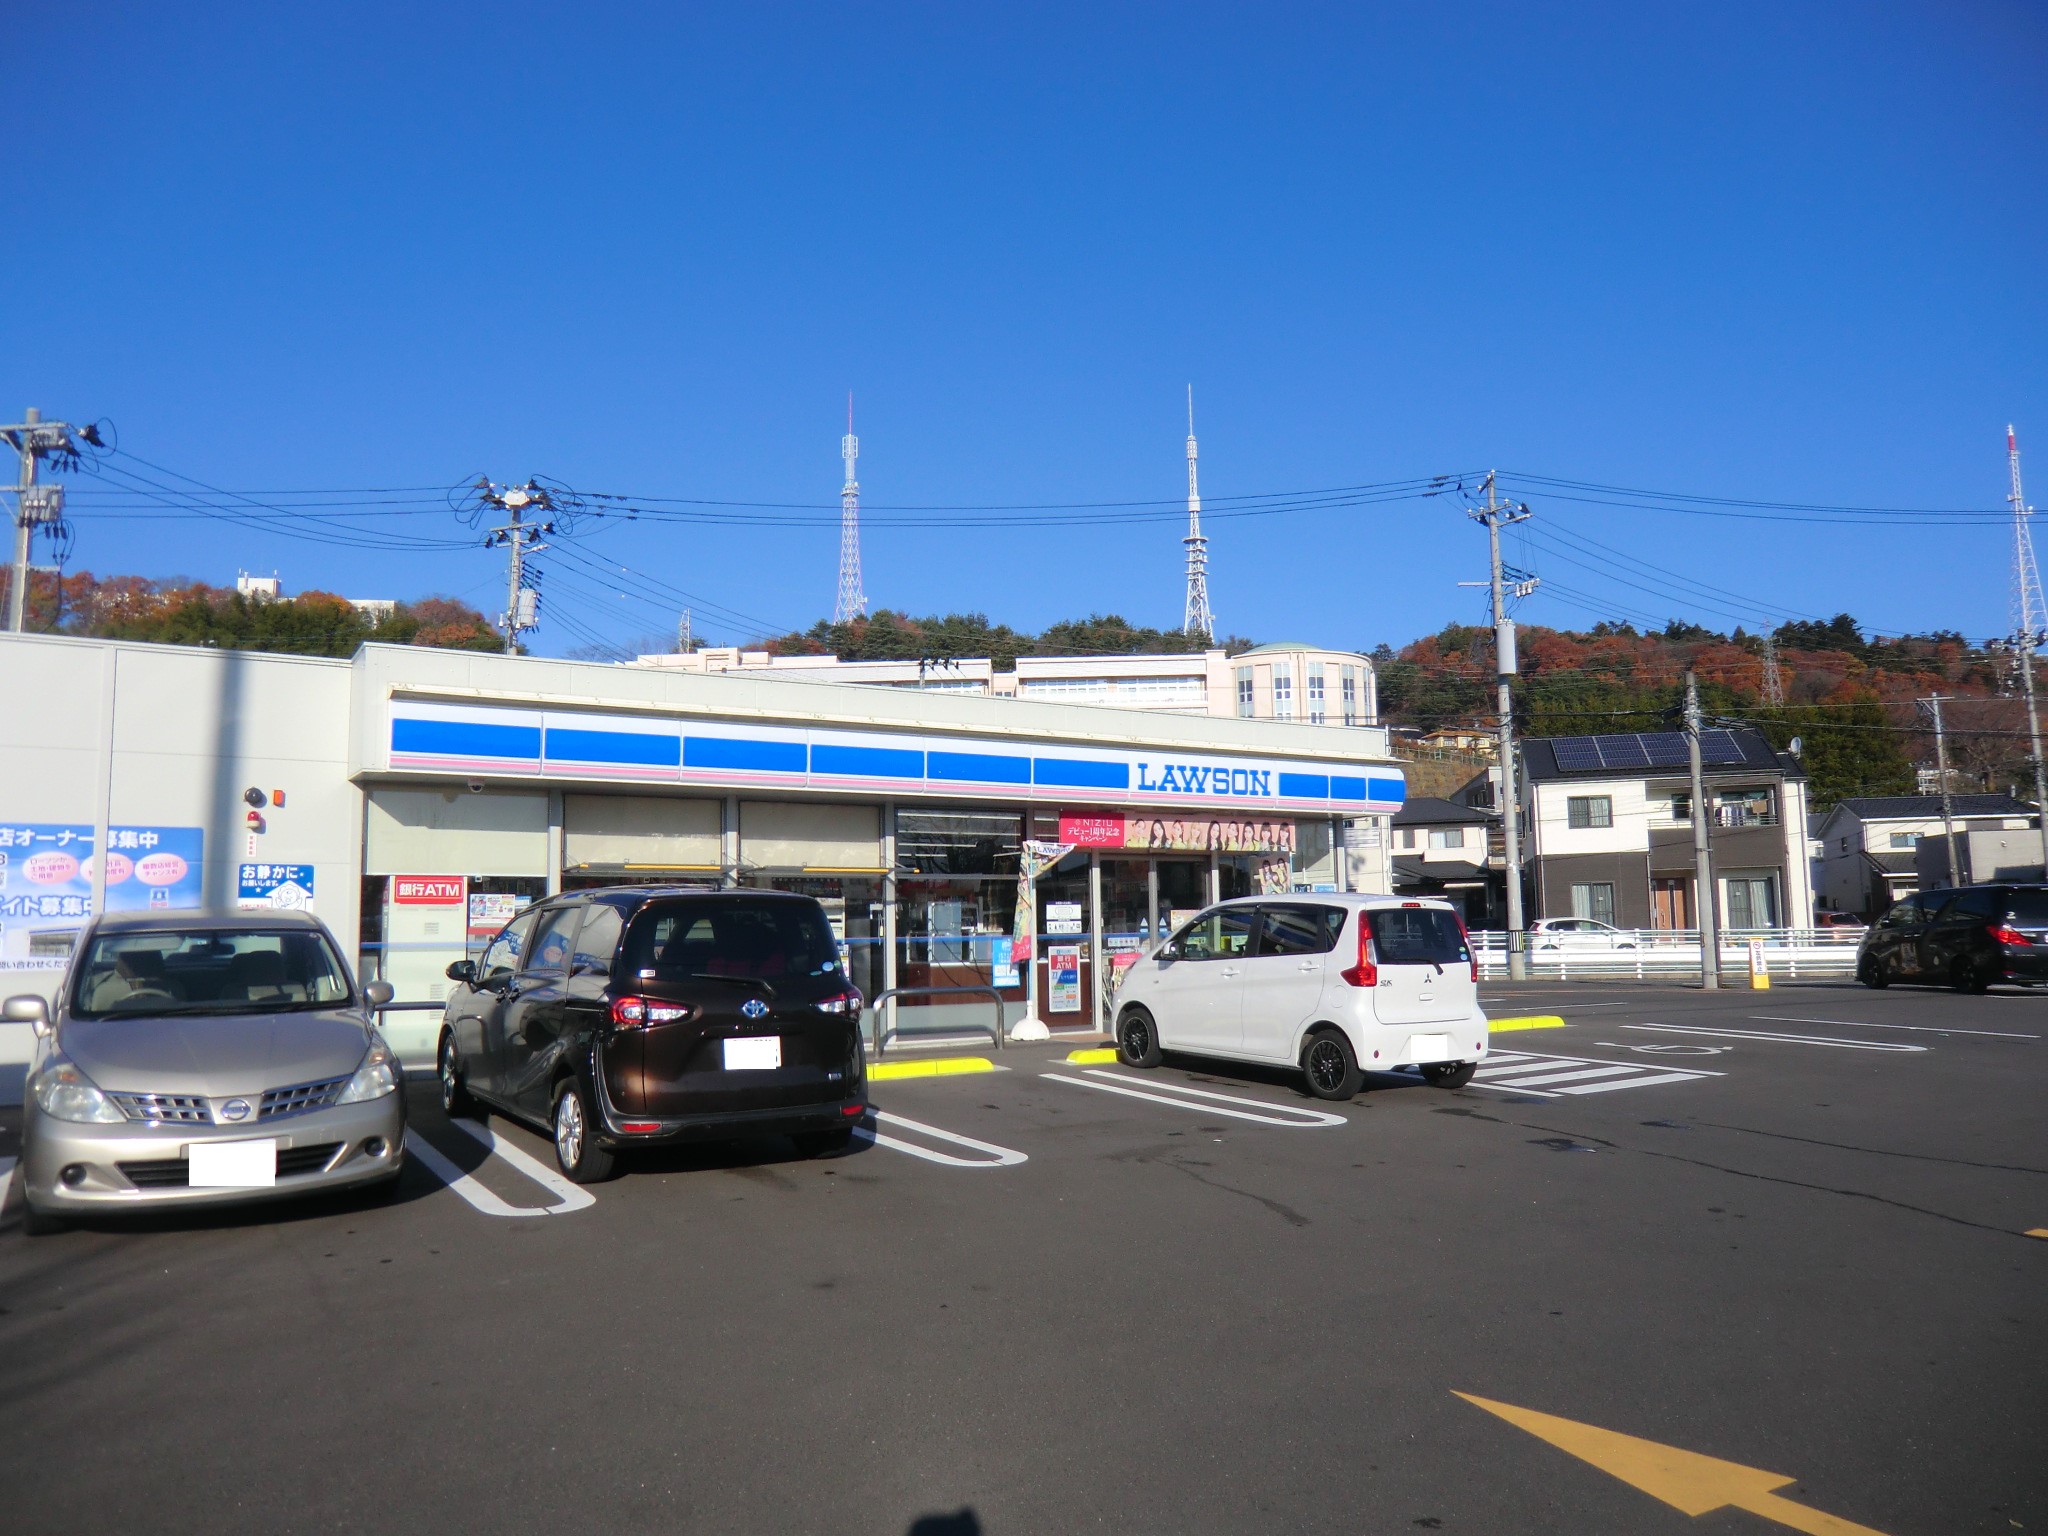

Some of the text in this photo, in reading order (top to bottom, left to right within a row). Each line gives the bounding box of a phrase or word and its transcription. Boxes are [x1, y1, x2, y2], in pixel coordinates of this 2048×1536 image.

[1137, 763, 1271, 796] LAWSON
[1067, 827, 1120, 837] デビュー1周年記念
[1080, 835, 1108, 843] キャンペーン
[242, 865, 298, 879] お静かに
[399, 883, 460, 897] 銀行ATM
